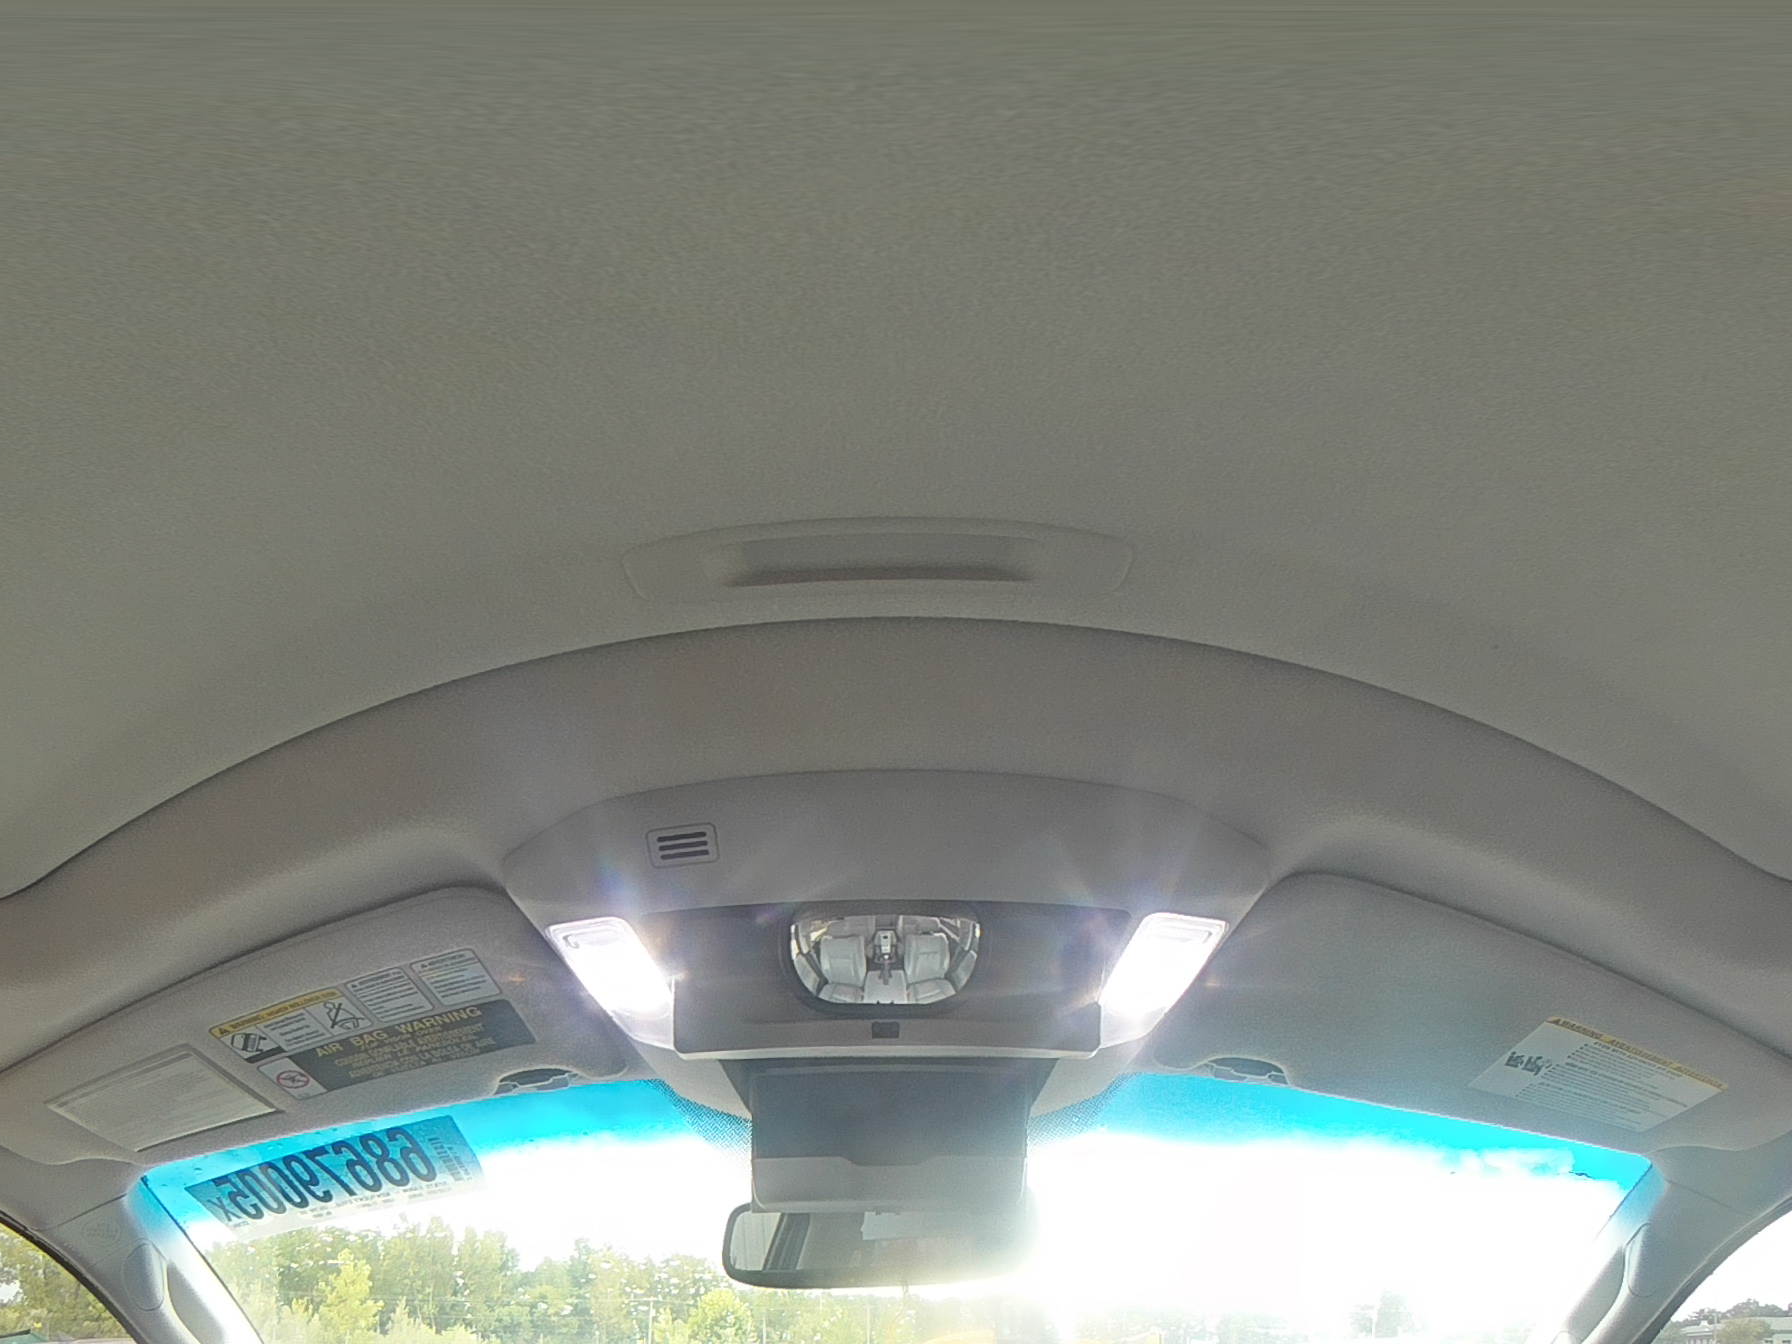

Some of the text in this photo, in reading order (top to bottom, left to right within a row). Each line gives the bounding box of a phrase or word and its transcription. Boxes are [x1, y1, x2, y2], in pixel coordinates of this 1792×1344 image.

[315, 1005, 483, 1058] AIR BAG WARNING
